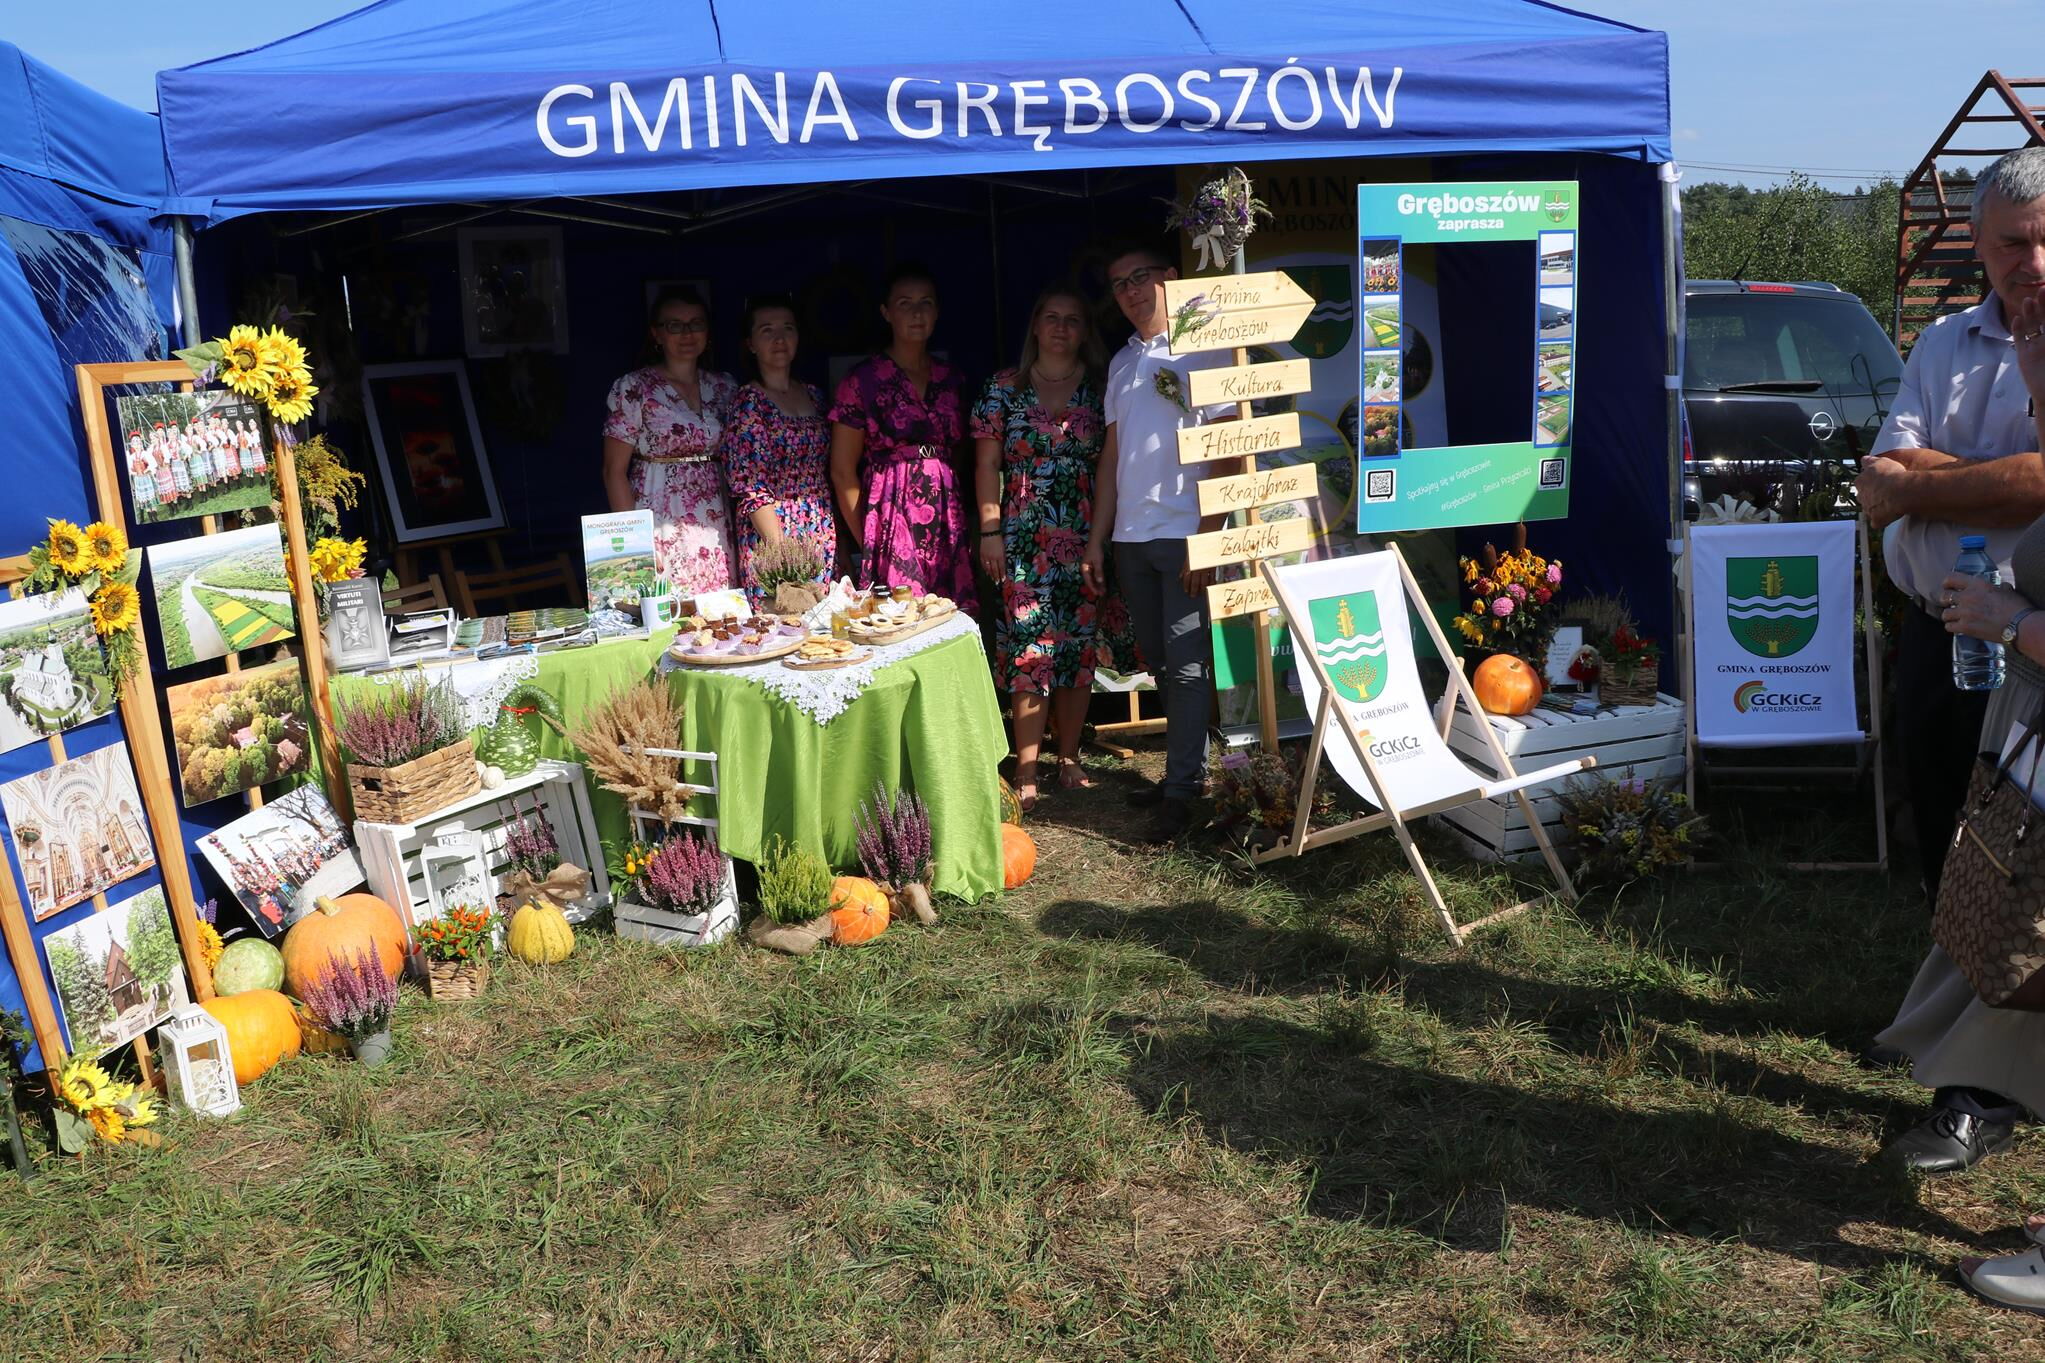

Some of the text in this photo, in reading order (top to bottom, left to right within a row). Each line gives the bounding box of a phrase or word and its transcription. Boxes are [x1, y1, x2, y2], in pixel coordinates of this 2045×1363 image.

[536, 57, 1403, 158] GMINA GRĘBOSZÓW
[1397, 190, 1540, 218] Gręboszów
[1437, 218, 1505, 232] zaprasza
[1210, 284, 1261, 307] Gmina
[1190, 316, 1269, 347] Gręboszów
[1221, 371, 1283, 397] Kultura
[1220, 473, 1299, 507] Krajobraz
[1220, 525, 1280, 559] Zabytki
[337, 592, 362, 600] VIRTUTI
[337, 599, 364, 607] MILITARI
[1224, 589, 1273, 614] Zapra
[1717, 663, 1831, 675] GMINA GRĘBOSZÓW
[1750, 693, 1822, 706] GCKiCz
[1762, 705, 1822, 713] GRĘBOSZOWIE
[1360, 702, 1409, 721] GRĘBOSZÓW
[1369, 736, 1421, 758] GCKiCz
